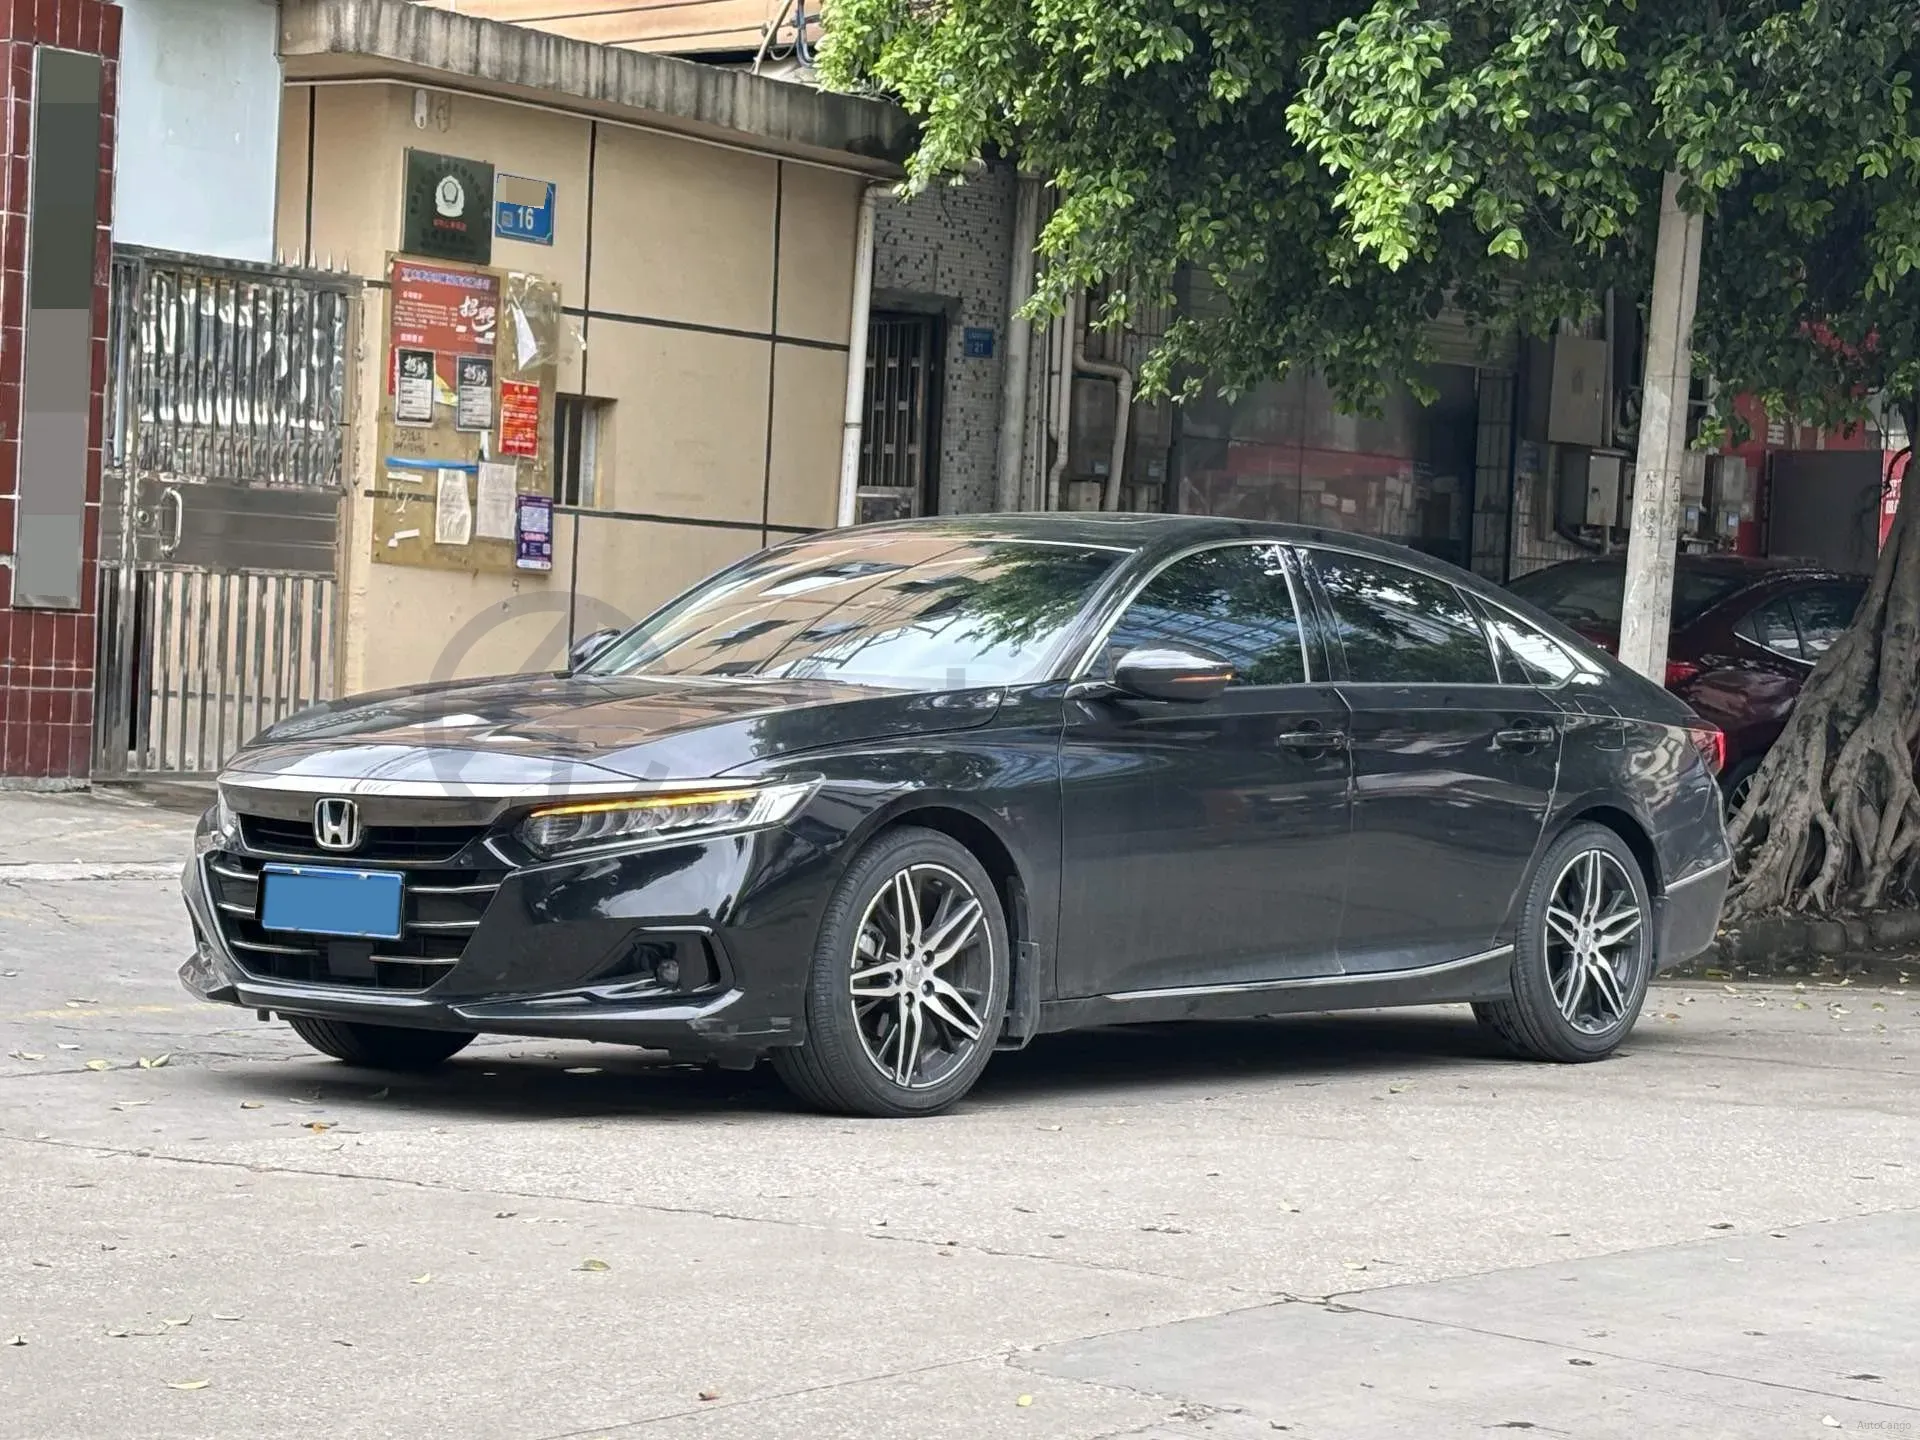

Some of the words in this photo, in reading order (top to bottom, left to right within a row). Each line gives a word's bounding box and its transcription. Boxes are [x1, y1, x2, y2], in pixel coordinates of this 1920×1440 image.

[518, 206, 534, 230] 16
[459, 295, 496, 331] 招聘
[1643, 471, 1658, 540] 禁止停车
